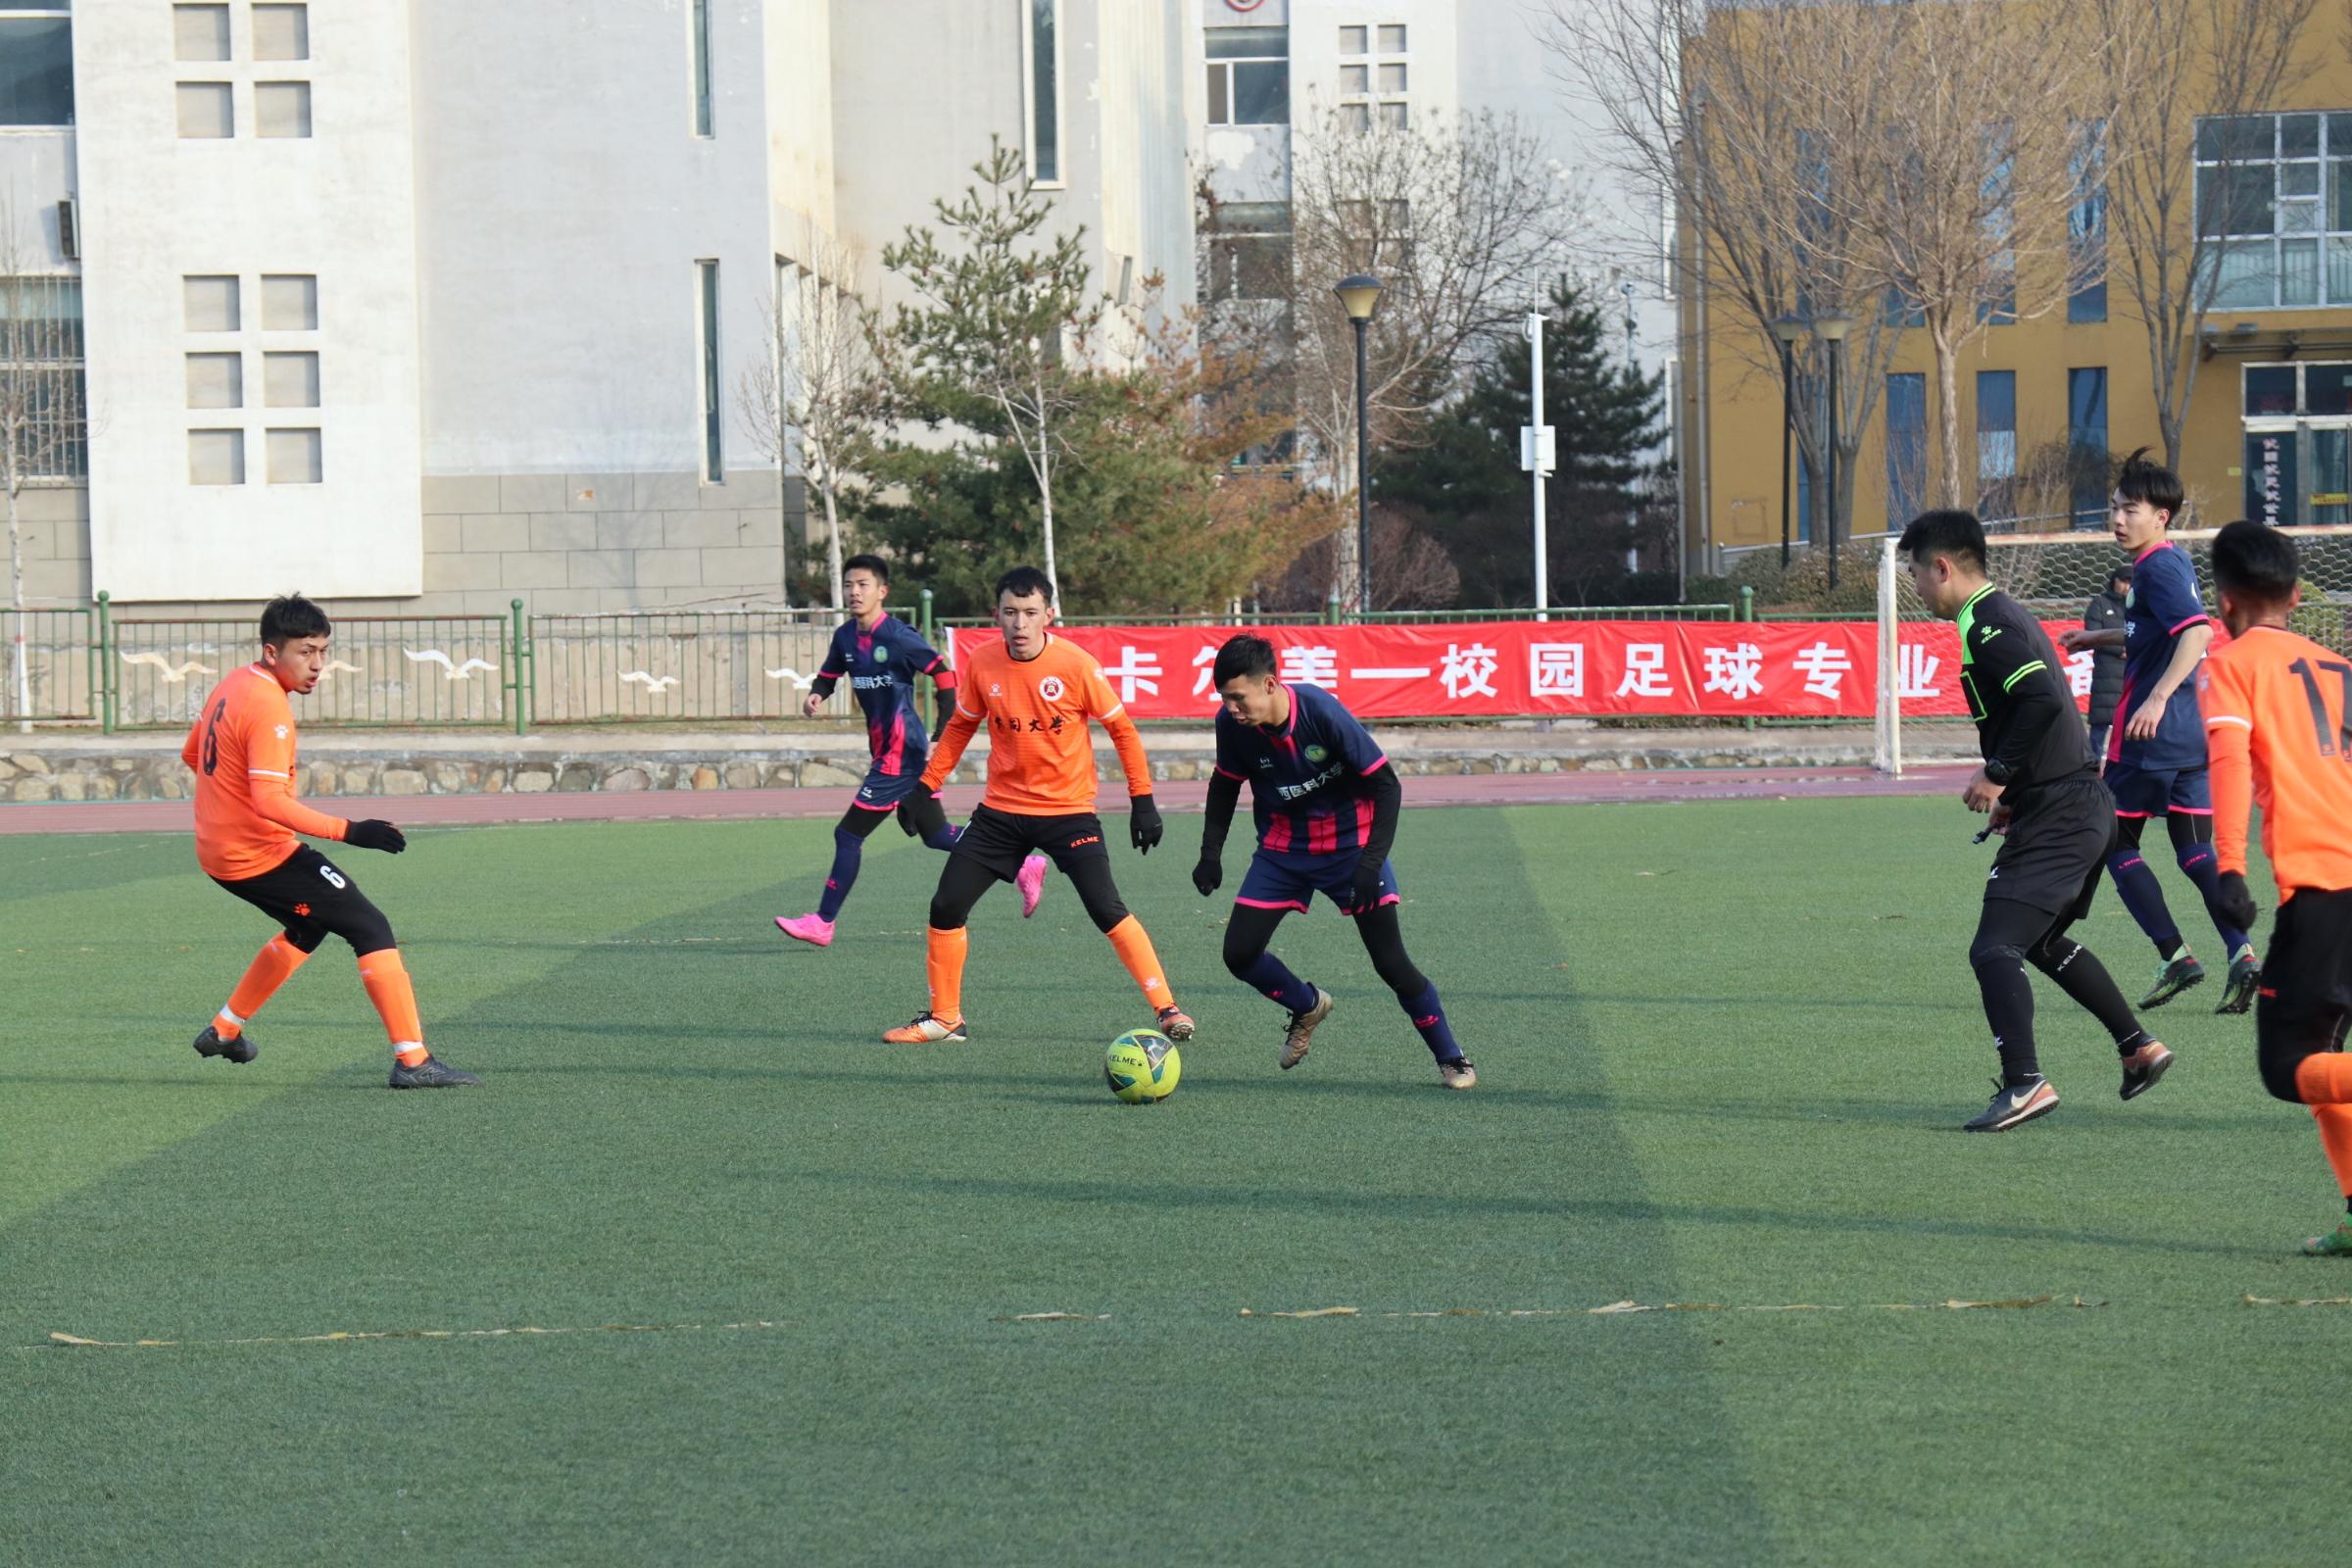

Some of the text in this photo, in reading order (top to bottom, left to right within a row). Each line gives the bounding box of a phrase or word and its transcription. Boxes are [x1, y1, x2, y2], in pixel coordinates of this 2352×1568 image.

[2288, 658, 2352, 761] 17
[1070, 836, 1098, 848] KELME
[319, 865, 346, 889] 6
